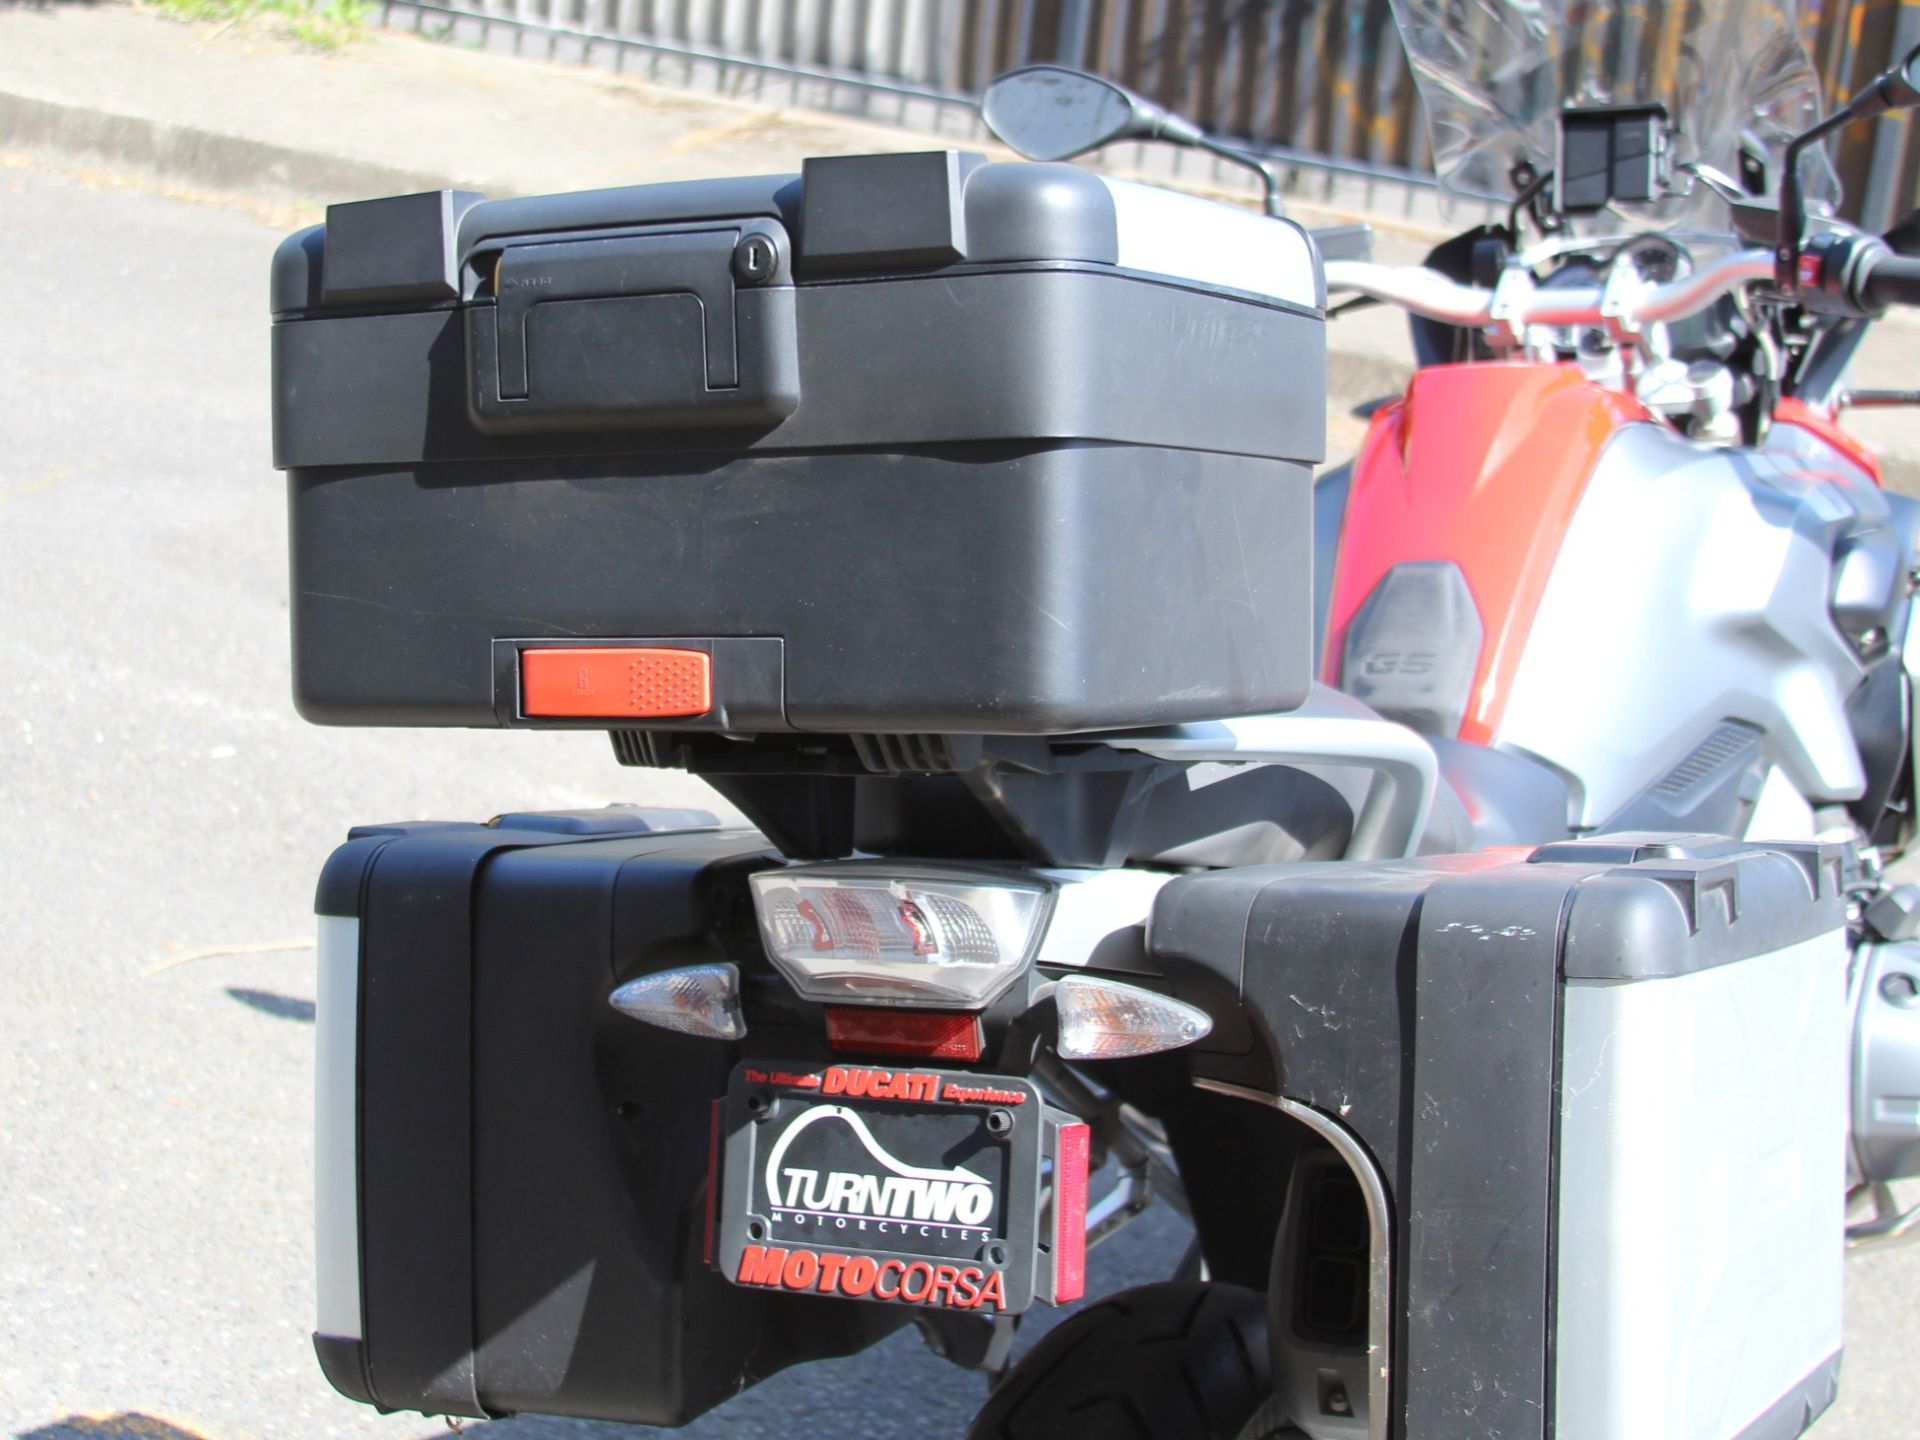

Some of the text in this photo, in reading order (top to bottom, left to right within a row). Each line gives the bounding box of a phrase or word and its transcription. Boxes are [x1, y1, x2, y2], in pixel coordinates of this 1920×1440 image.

[1360, 653, 1439, 674] GS
[745, 1069, 767, 1084] The
[822, 1067, 940, 1102] DUCATI
[942, 1083, 1027, 1104] Experience
[783, 1167, 994, 1226] TURNTWO
[771, 1212, 991, 1242] MOTORCYCLES
[738, 1244, 1007, 1312] MOTOCORSA
